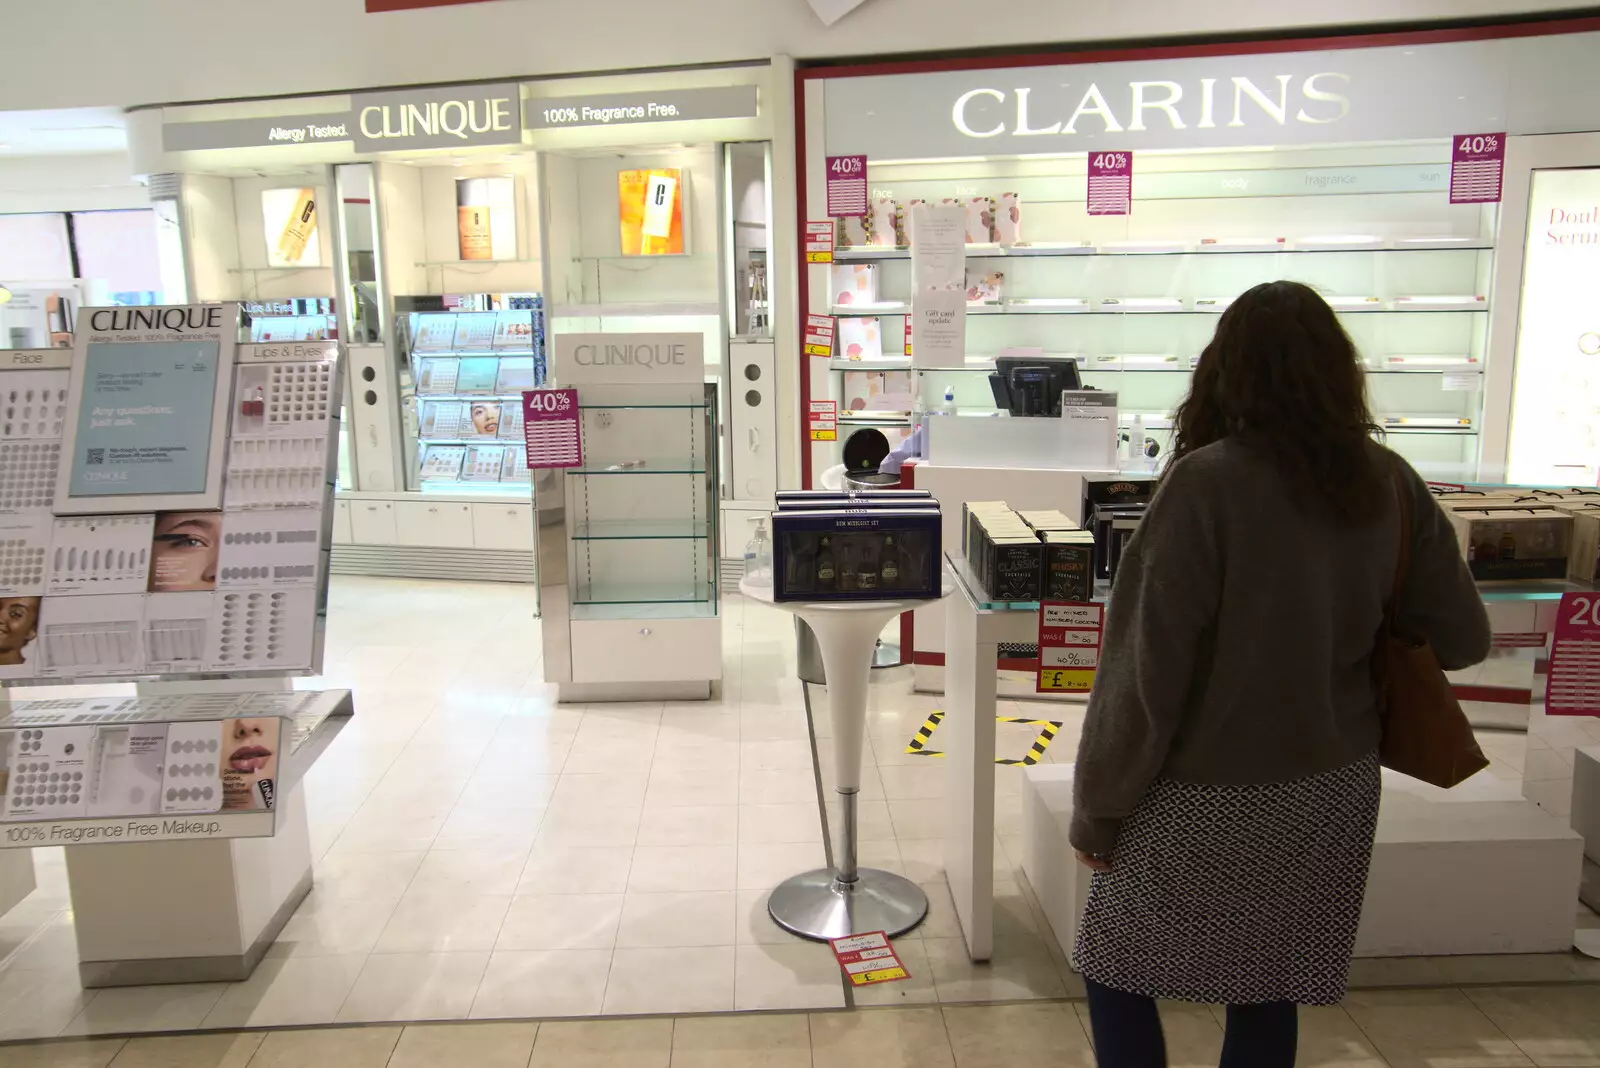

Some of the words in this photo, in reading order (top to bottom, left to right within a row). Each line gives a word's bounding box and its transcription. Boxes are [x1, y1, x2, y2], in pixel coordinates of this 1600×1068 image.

[543, 107, 578, 123] 100%
[582, 106, 644, 122] Fragrance
[648, 102, 679, 117] Free.
[952, 72, 1351, 138] CLARINS
[360, 98, 511, 139] CLINIQUE
[268, 127, 305, 142] Allergy
[307, 124, 348, 138] Tested.
[1459, 136, 1498, 153] 40%
[831, 158, 862, 173] 40%
[1093, 153, 1127, 169] 40%
[1221, 178, 1250, 190] body
[1305, 174, 1357, 187] fragrance
[1419, 171, 1441, 182] sun
[872, 187, 893, 198] face
[91, 307, 223, 332] CLINIQUE
[925, 309, 938, 317] Gift
[928, 317, 951, 325] update
[12, 352, 43, 364] Face
[253, 345, 279, 359] Lips
[281, 347, 290, 356] &
[294, 345, 322, 357] Eyes
[573, 344, 686, 369] CLINIQUE
[529, 391, 570, 412] 40%
[557, 403, 570, 411] OFF
[1052, 672, 1063, 687] £
[5, 827, 45, 843] 100%
[50, 825, 123, 842] Fragrance
[127, 822, 158, 836] Free
[162, 820, 222, 835] Makeup.
